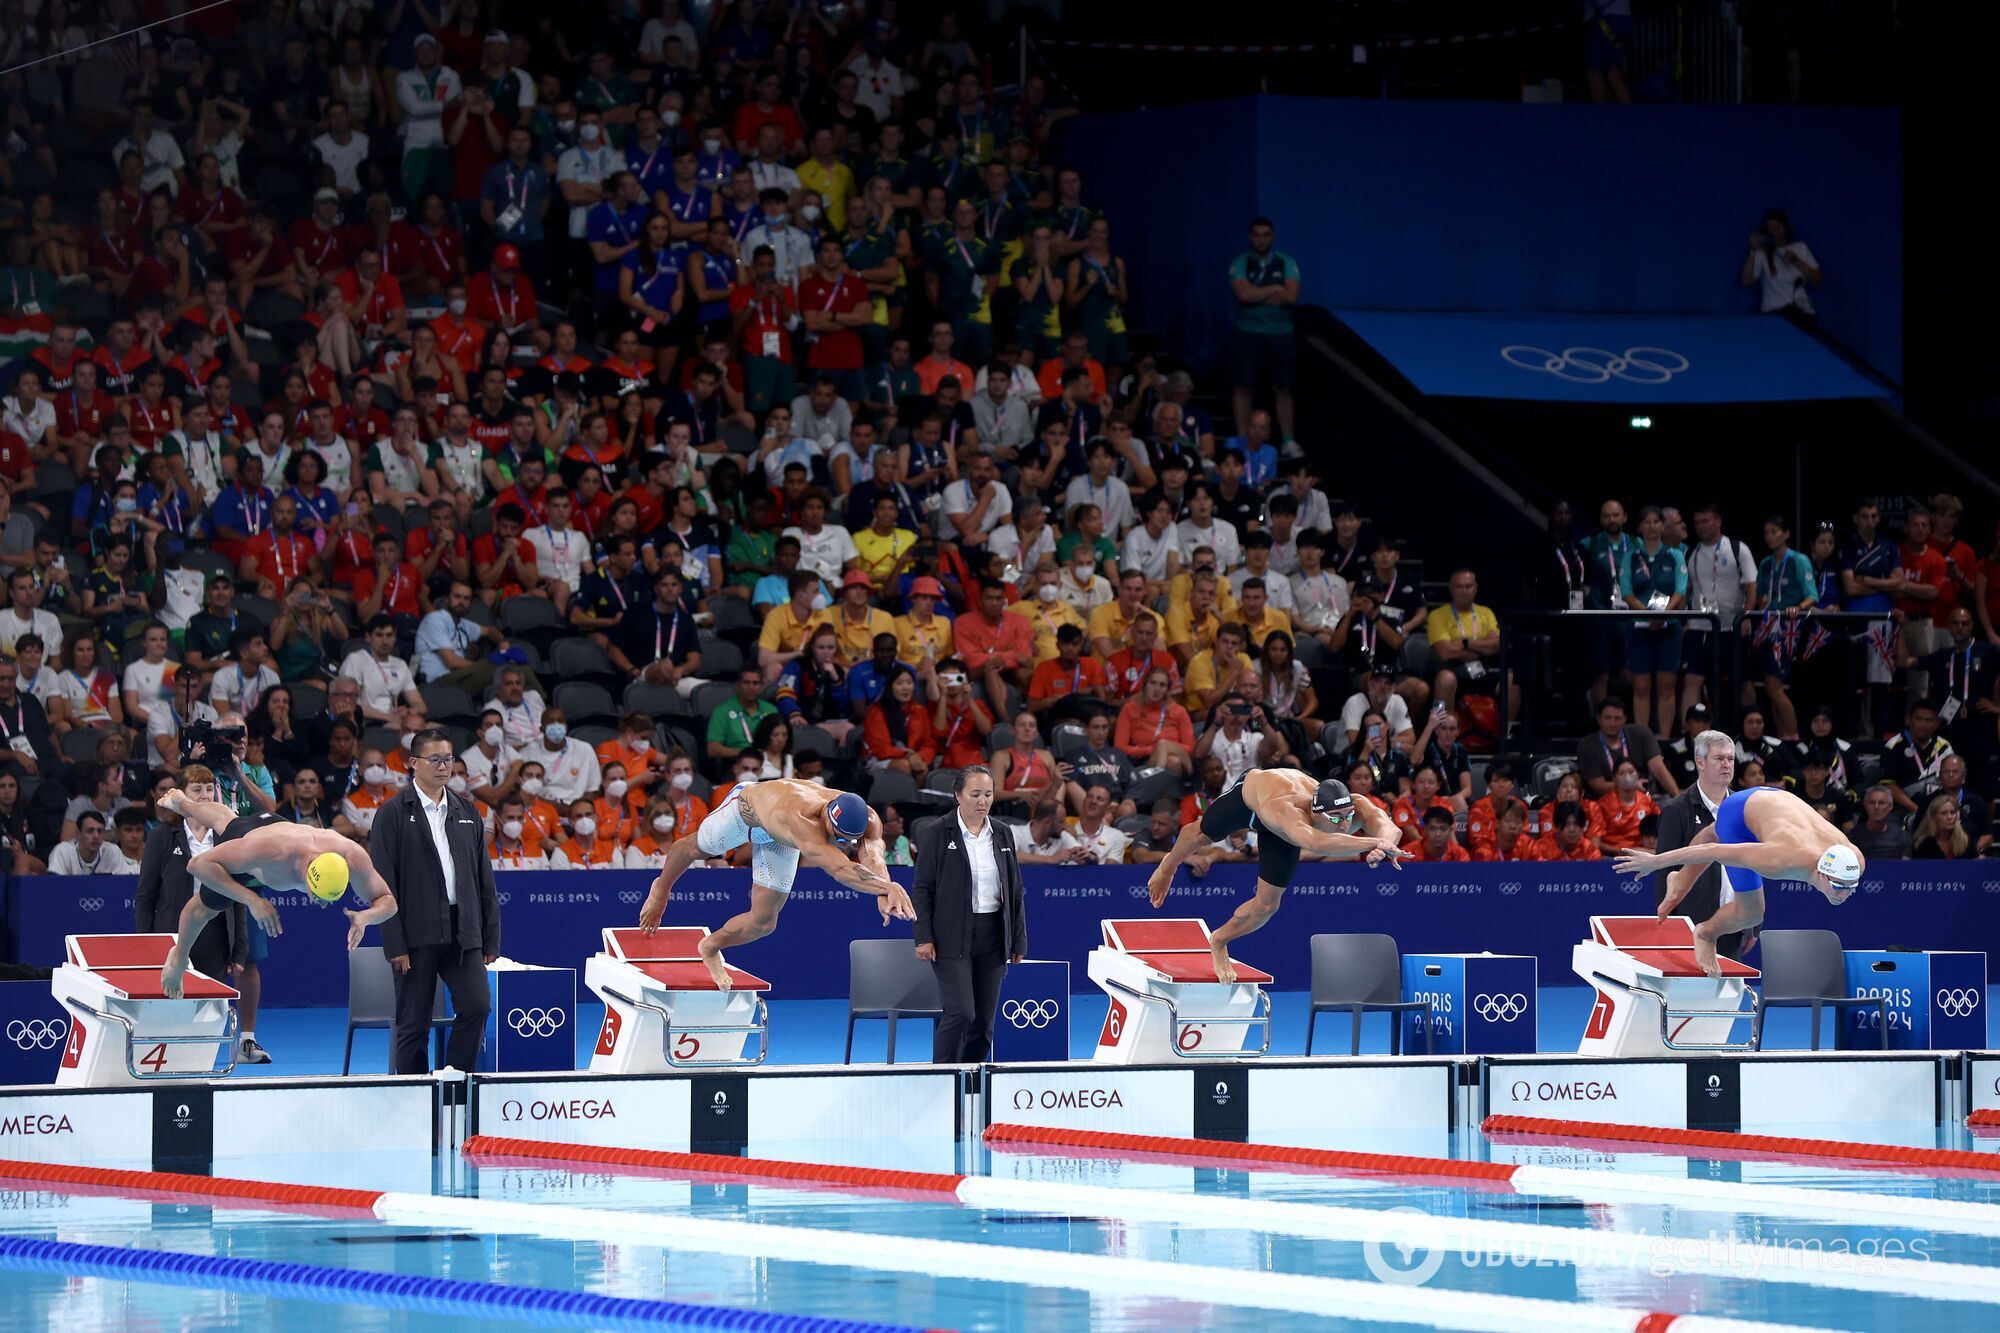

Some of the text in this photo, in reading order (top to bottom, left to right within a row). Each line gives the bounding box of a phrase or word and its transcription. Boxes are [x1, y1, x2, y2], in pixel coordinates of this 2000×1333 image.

[310, 866, 321, 882] AUS
[668, 891, 731, 902] ARIS 2024
[790, 890, 859, 900] PARIS 2024
[1044, 887, 1111, 897] PARIS 2024
[1169, 886, 1236, 896] PARIS 2024
[1293, 885, 1359, 895] PARIS 2024
[1415, 884, 1482, 894] PARIS 2024
[1539, 882, 1604, 893] PARIS 2024
[1901, 881, 1966, 892] PARIS 2024
[270, 898, 297, 908] ARIS
[530, 893, 600, 903] PARIS 2024
[1110, 1008, 1120, 1039] 6
[1414, 1014, 1452, 1036] 224
[1596, 1003, 1607, 1032] 7
[605, 1018, 615, 1049] 5
[1178, 1023, 1203, 1051] 6
[69, 1030, 79, 1062] 4
[674, 1032, 700, 1060] 5
[140, 1043, 168, 1073] 4
[1040, 1089, 1123, 1109] OMEGA
[1537, 1081, 1617, 1102] OMEGA
[530, 1099, 616, 1121] OMEGA
[0, 1114, 74, 1136] MEGA
